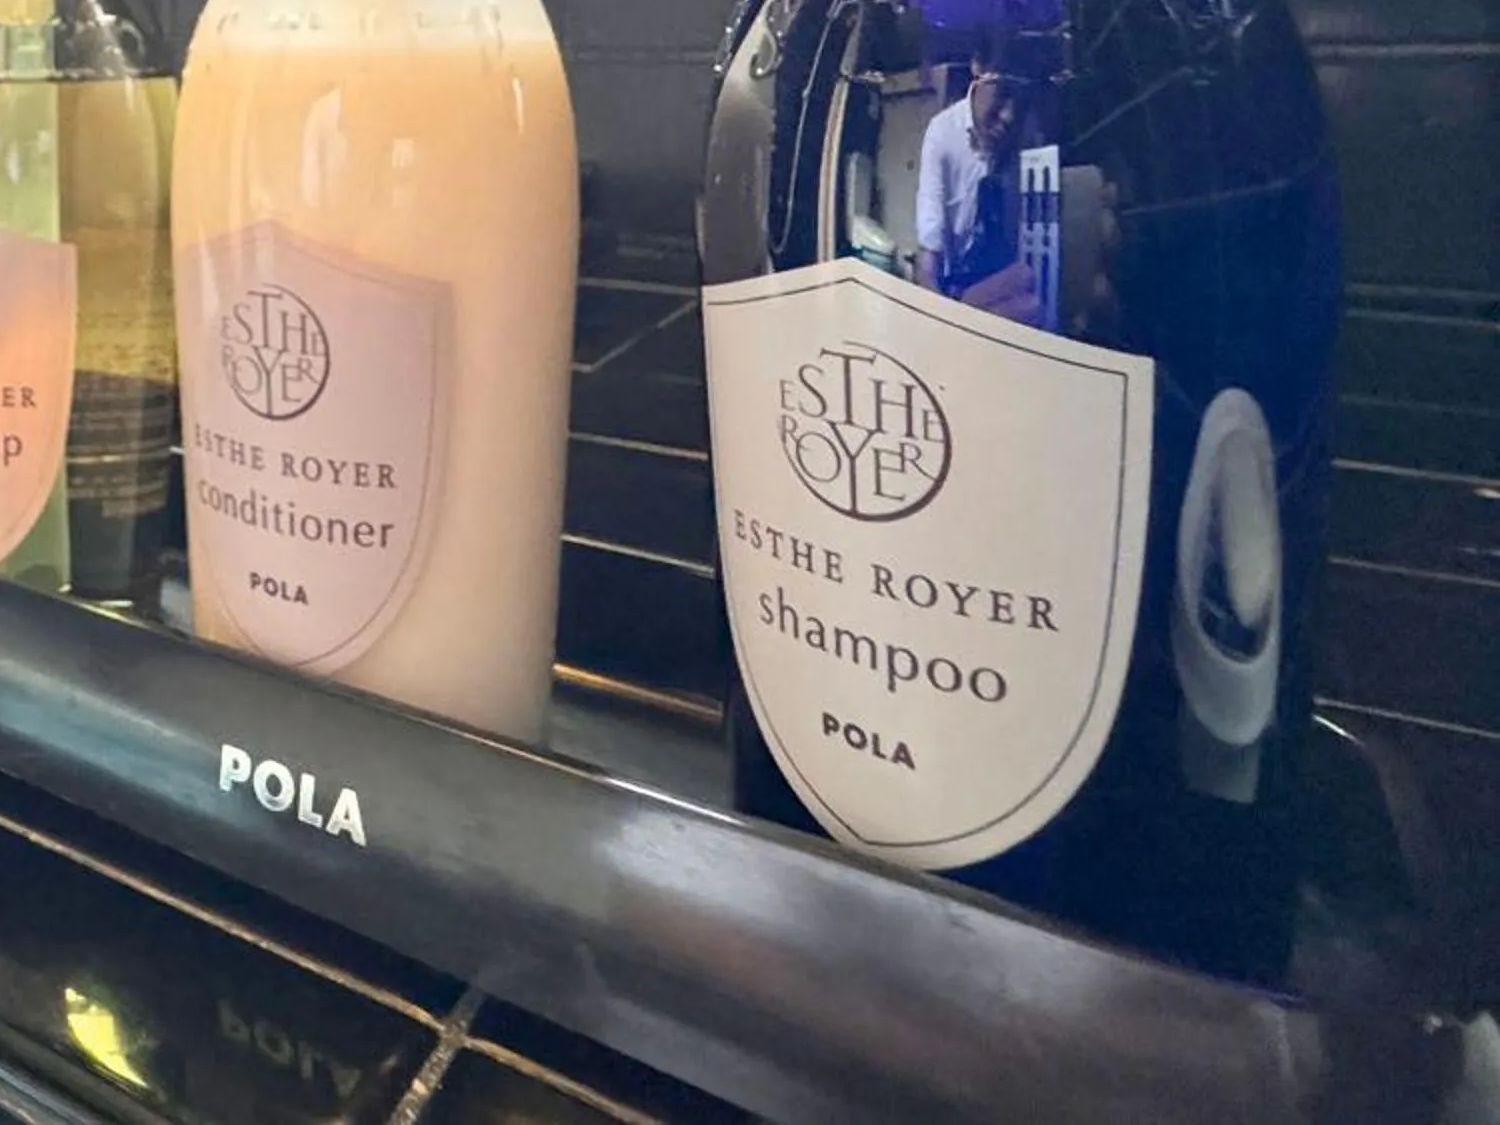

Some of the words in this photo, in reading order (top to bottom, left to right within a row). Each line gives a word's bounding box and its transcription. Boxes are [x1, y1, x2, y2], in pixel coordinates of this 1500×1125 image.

[280, 451, 398, 490] ROYER
[199, 479, 396, 549] conditioner
[249, 571, 309, 606] POLA
[734, 509, 844, 584] ESTHE
[871, 562, 1060, 633] ROYER
[759, 586, 1008, 704] shampoo
[821, 710, 917, 771] POLA
[219, 743, 367, 847] POLA
